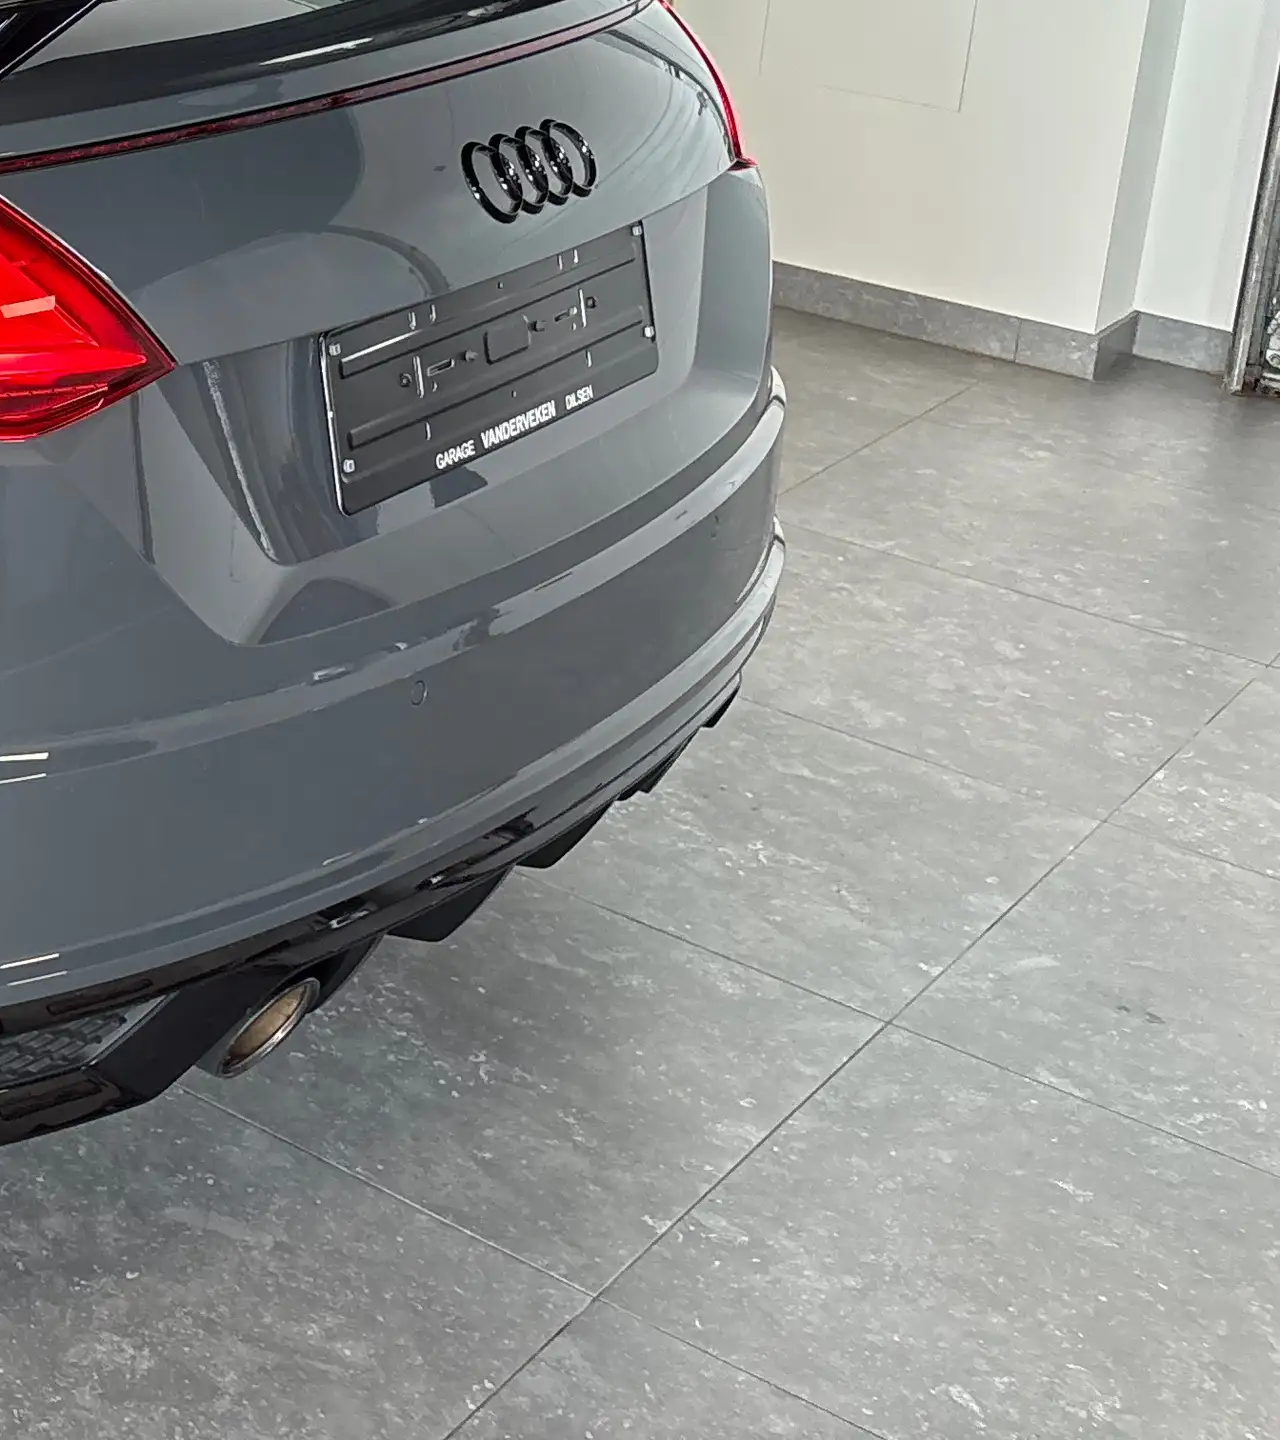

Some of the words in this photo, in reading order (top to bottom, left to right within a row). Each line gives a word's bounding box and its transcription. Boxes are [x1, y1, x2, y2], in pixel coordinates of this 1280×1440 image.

[435, 439, 476, 469] GARAGE
[481, 400, 556, 449] VANDERVEKEN
[564, 384, 594, 410] DILSEN
